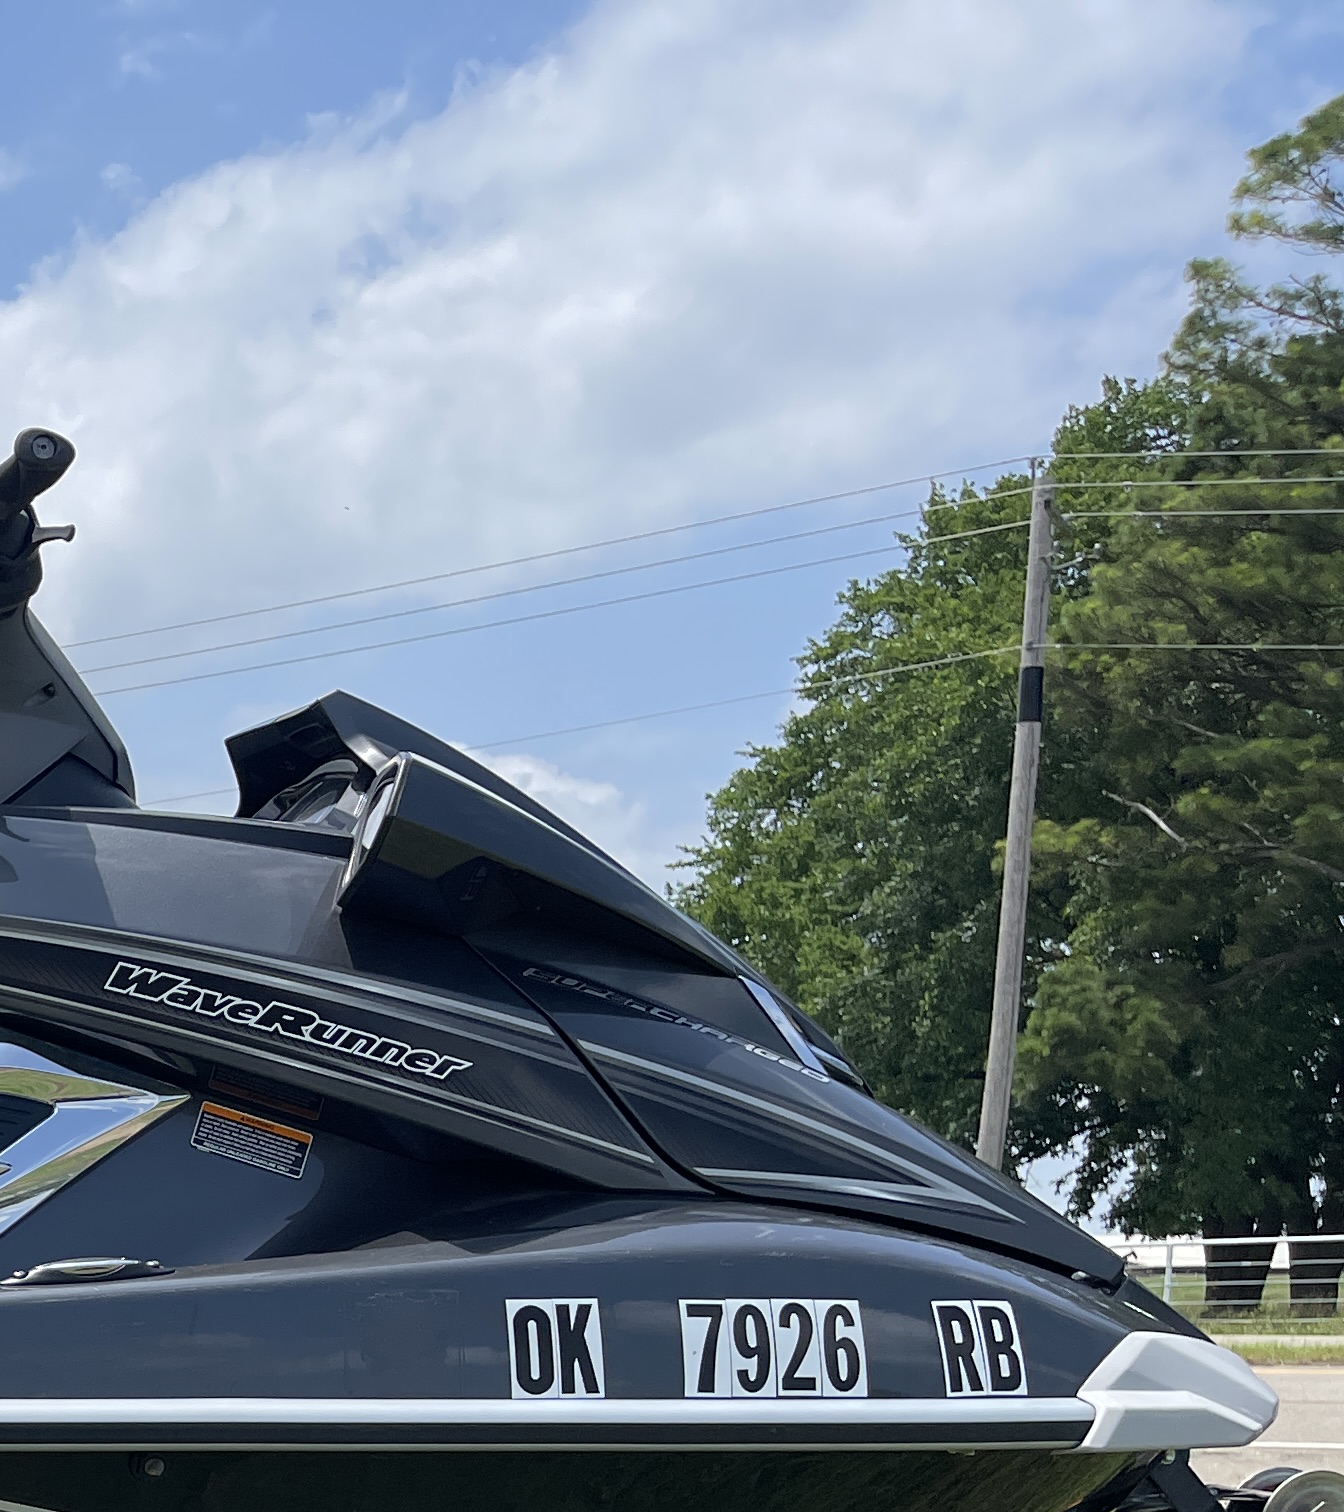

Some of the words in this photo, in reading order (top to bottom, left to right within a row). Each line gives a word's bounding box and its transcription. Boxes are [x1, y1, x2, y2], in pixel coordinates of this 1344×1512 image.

[104, 961, 474, 1080] WaveRunner
[512, 1304, 600, 1396] OK
[685, 1302, 861, 1394] 7926
[939, 1304, 1023, 1394] RB
